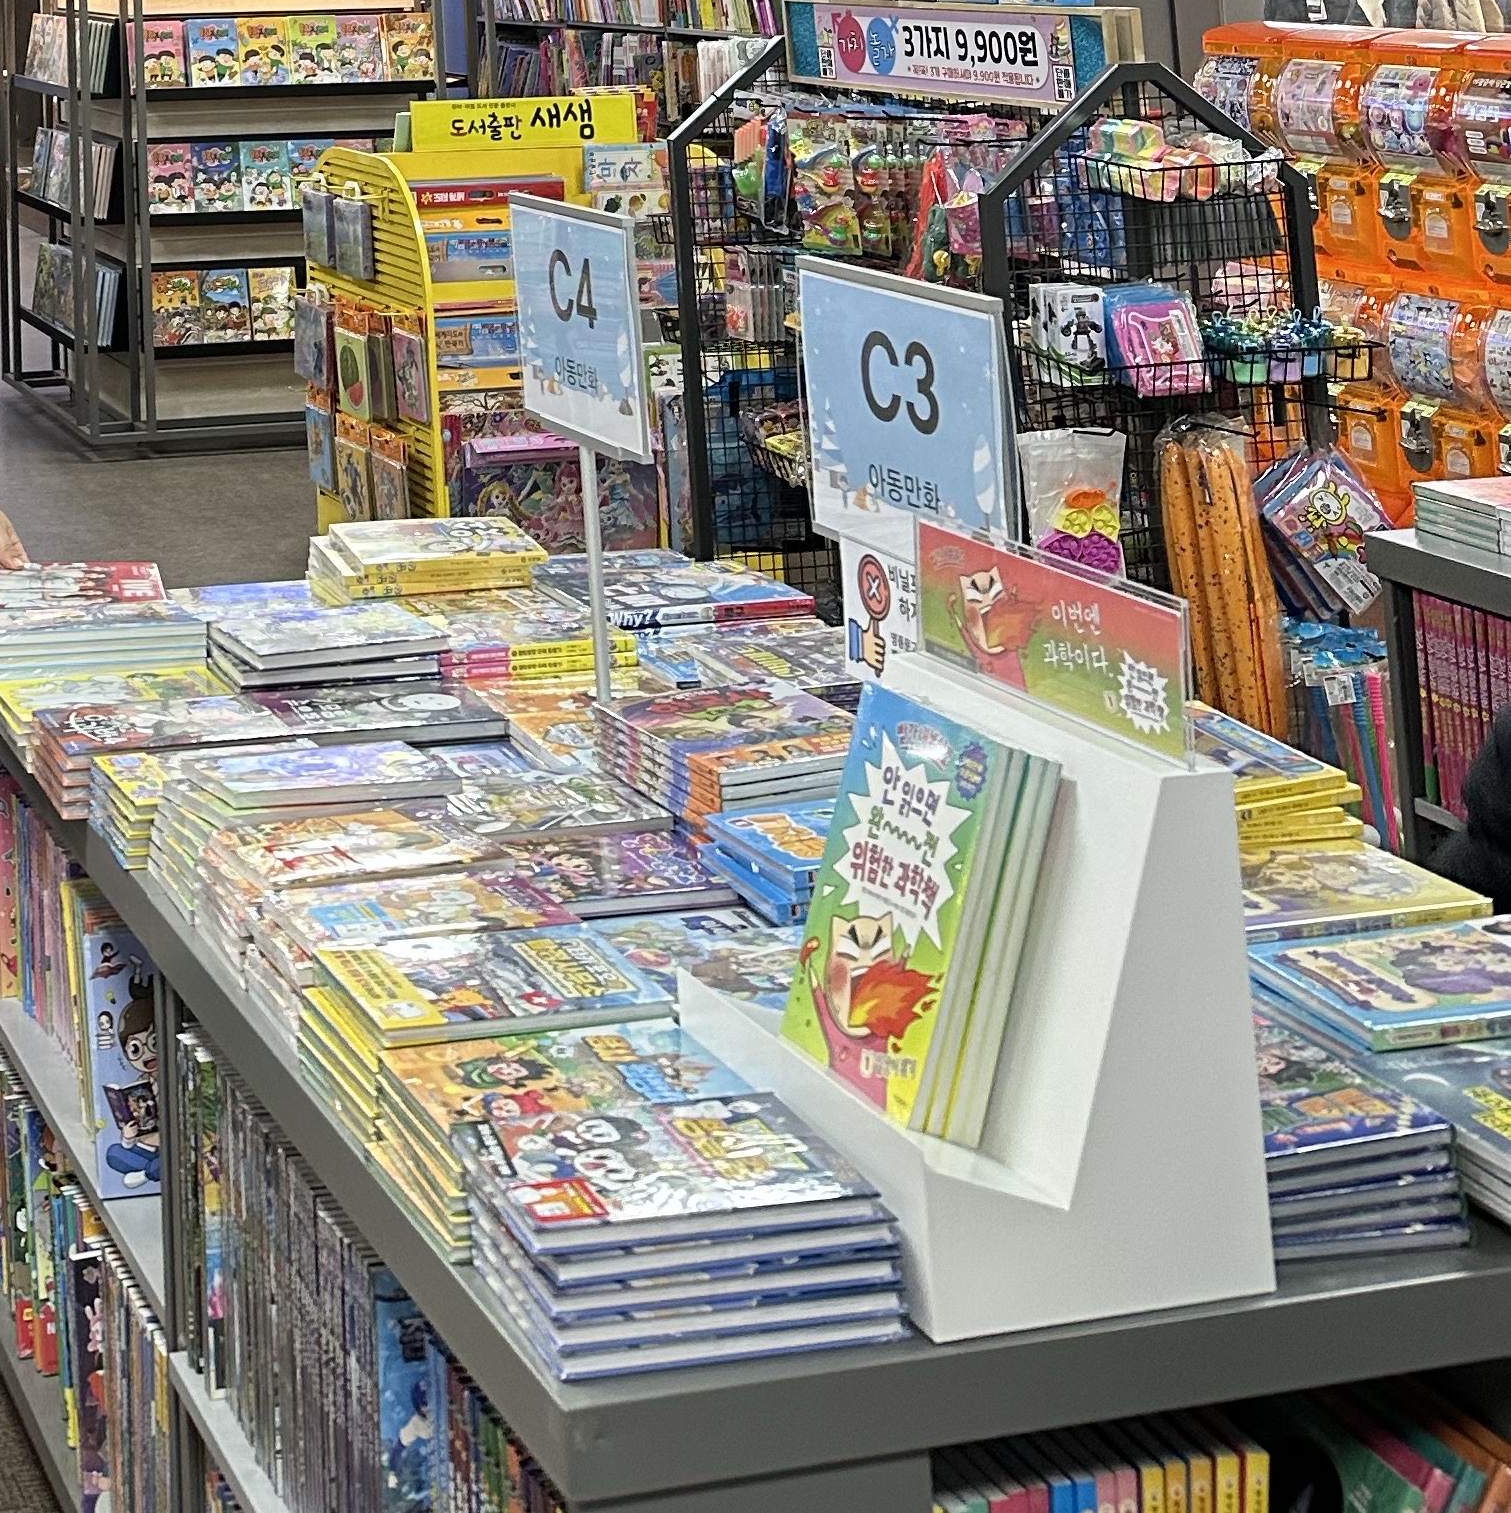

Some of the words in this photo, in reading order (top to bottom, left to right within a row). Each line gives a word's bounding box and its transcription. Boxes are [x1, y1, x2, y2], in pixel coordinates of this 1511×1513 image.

[902, 25, 951, 60] 3가지
[955, 28, 1039, 67] 9,900원
[449, 111, 524, 141] 도서출판
[530, 98, 596, 140] 새샘
[548, 248, 598, 330] C4
[554, 355, 600, 394] 아동만화
[860, 330, 940, 435] C3
[869, 463, 941, 514] 아동만화
[609, 608, 660, 629] Why?
[1051, 599, 1102, 636] 이번엔
[882, 765, 901, 807] 안
[898, 780, 941, 828] 읽으면
[850, 840, 895, 889] 위험한
[894, 861, 941, 921] 과학책
